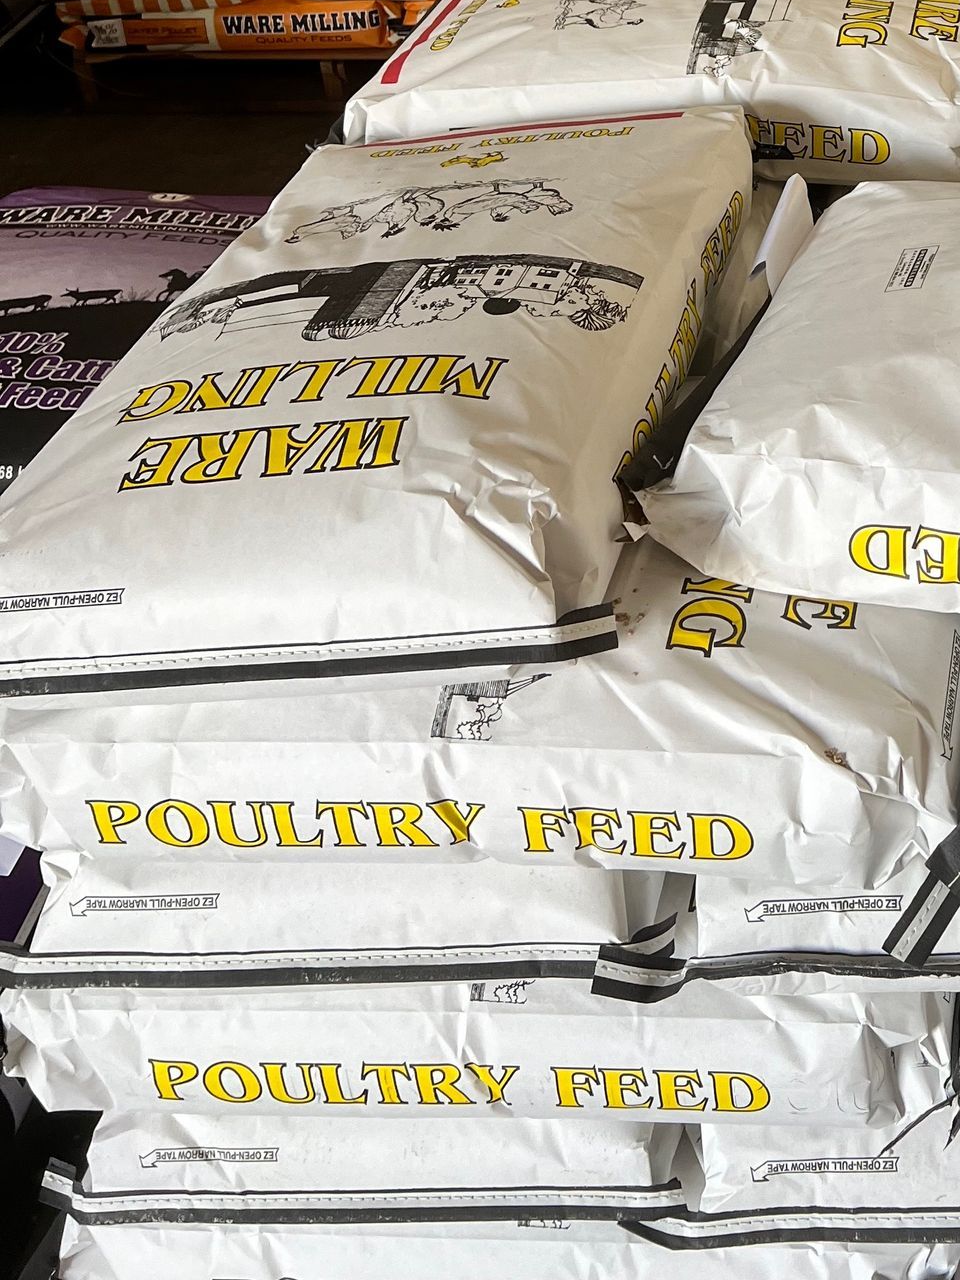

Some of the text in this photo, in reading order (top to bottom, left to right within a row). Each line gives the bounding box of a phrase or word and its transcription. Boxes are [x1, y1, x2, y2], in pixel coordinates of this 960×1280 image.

[222, 9, 380, 36] WARE MILLING
[470, 126, 636, 149] POULTRY
[0, 204, 119, 225] WARE
[15, 229, 132, 241] QUALITY
[45, 223, 226, 235] WWW.WAREMILLING.NET
[0, 330, 67, 356] 10%
[116, 354, 510, 427] MILLING
[116, 415, 411, 494] WARE
[10, 592, 119, 610] EZ OPEN-PULL NARROW
[85, 798, 755, 862] POULTRY FEED
[86, 897, 214, 909] EZ OPEN-PULL NARROW TAPE
[763, 898, 898, 914] EZ OPEN-PULL NARROW TAPE
[148, 1057, 772, 1114] POULTRY FEED
